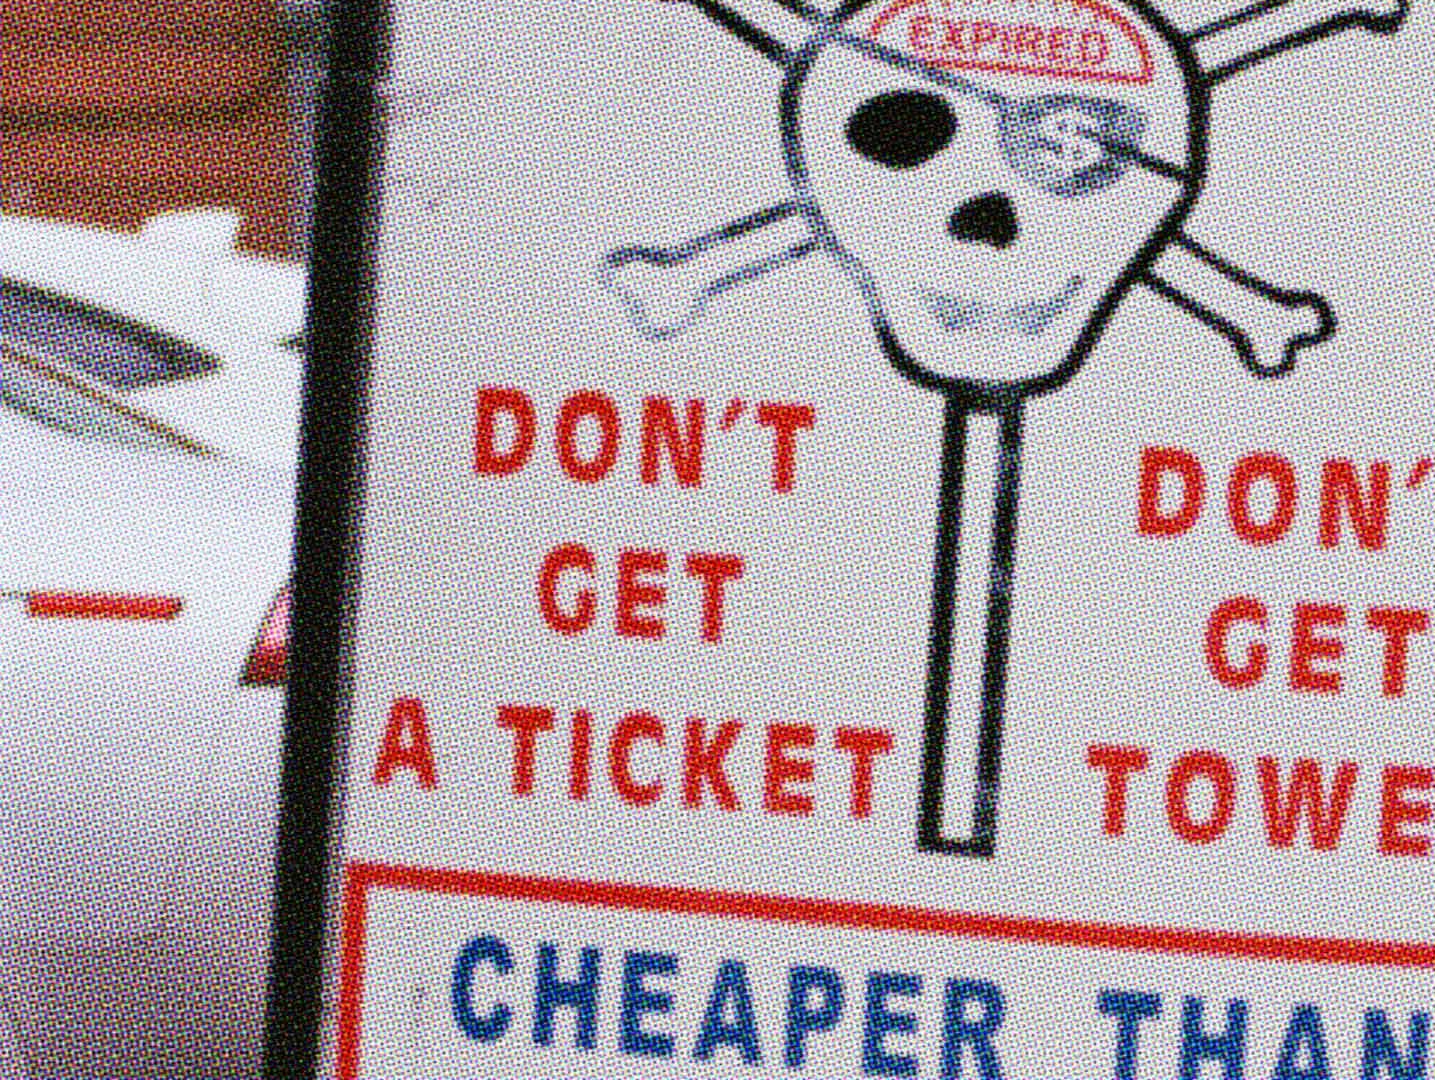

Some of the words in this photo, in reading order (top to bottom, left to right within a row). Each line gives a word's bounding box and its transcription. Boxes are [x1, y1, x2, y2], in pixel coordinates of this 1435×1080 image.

[908, 12, 1111, 69] EXPIRED
[472, 385, 817, 494] DON'T
[537, 542, 745, 645] GET
[1205, 595, 1430, 698] GET
[371, 695, 439, 791] A
[496, 704, 895, 820] TICKET
[450, 934, 1008, 1080] CHEAPER
[1096, 987, 1431, 1080] THAN
